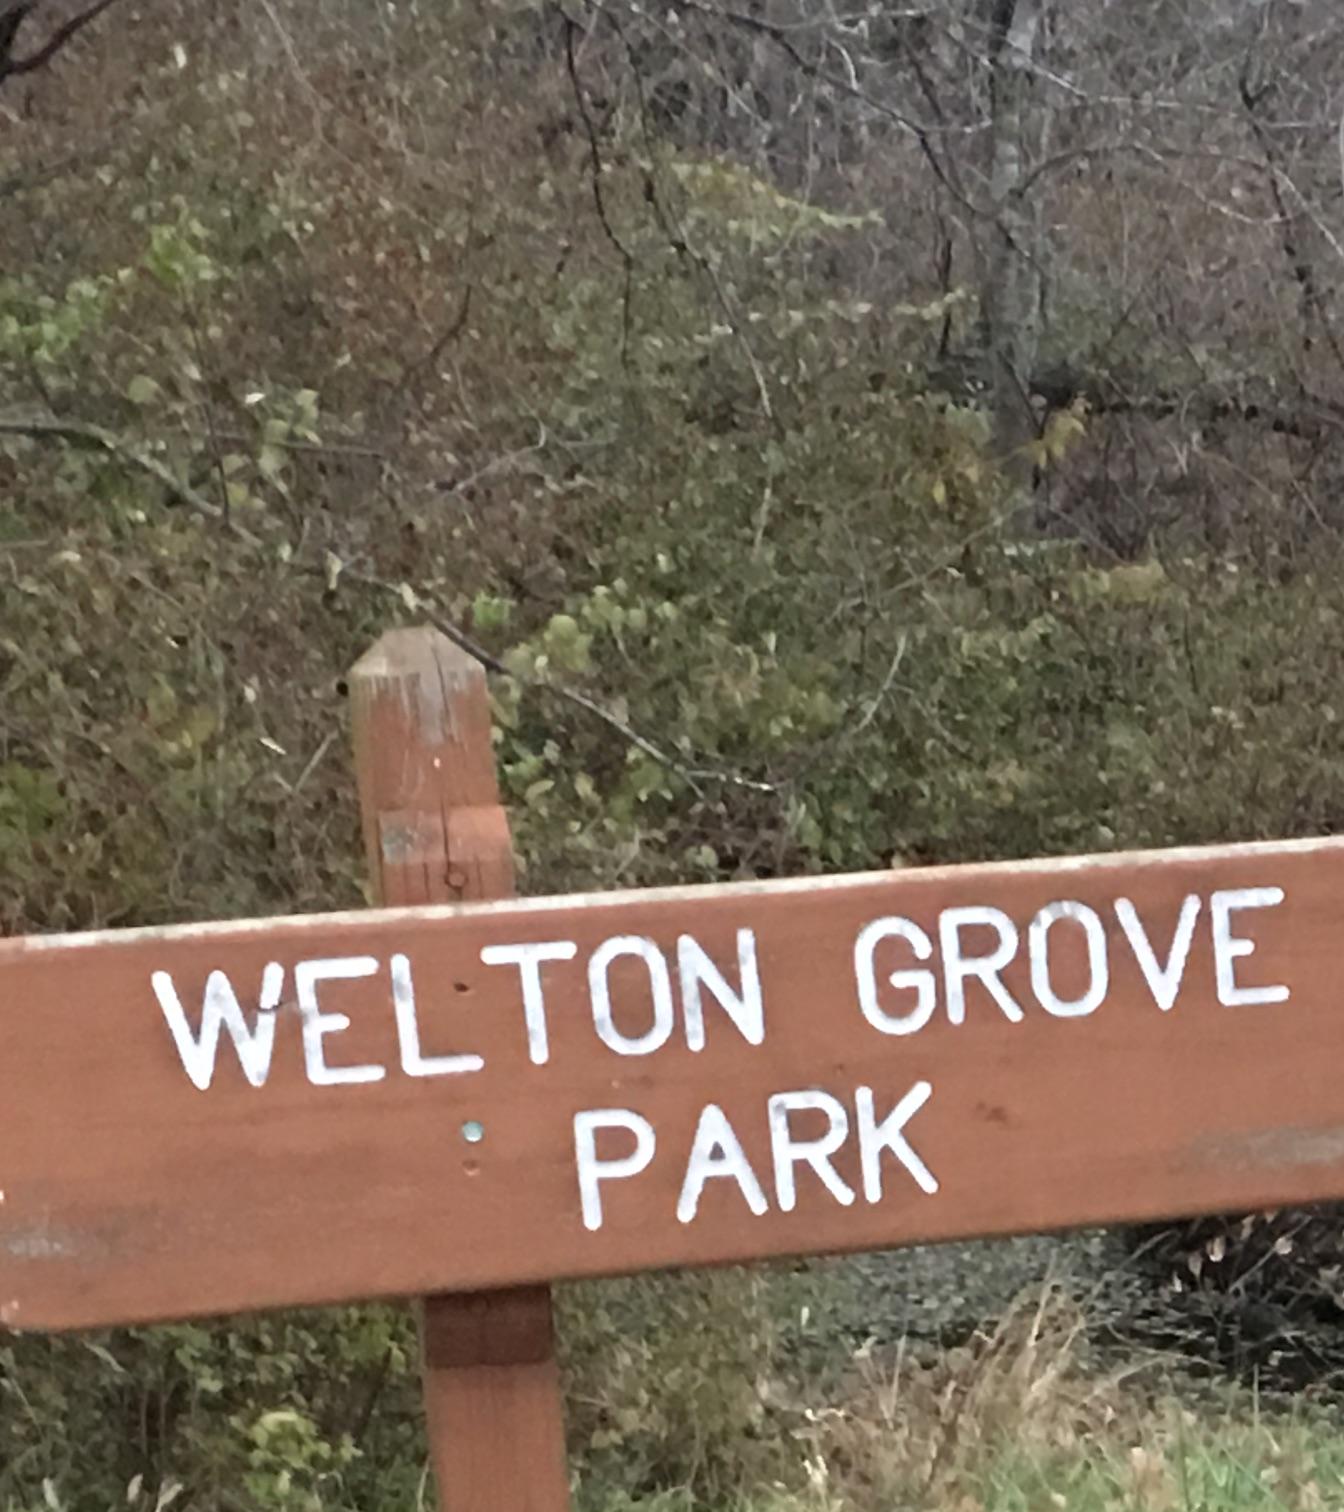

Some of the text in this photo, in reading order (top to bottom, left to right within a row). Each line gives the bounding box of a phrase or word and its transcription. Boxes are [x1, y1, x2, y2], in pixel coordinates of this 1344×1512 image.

[152, 887, 1290, 1090] WELTON GROVE
[574, 1081, 938, 1231] PARK
